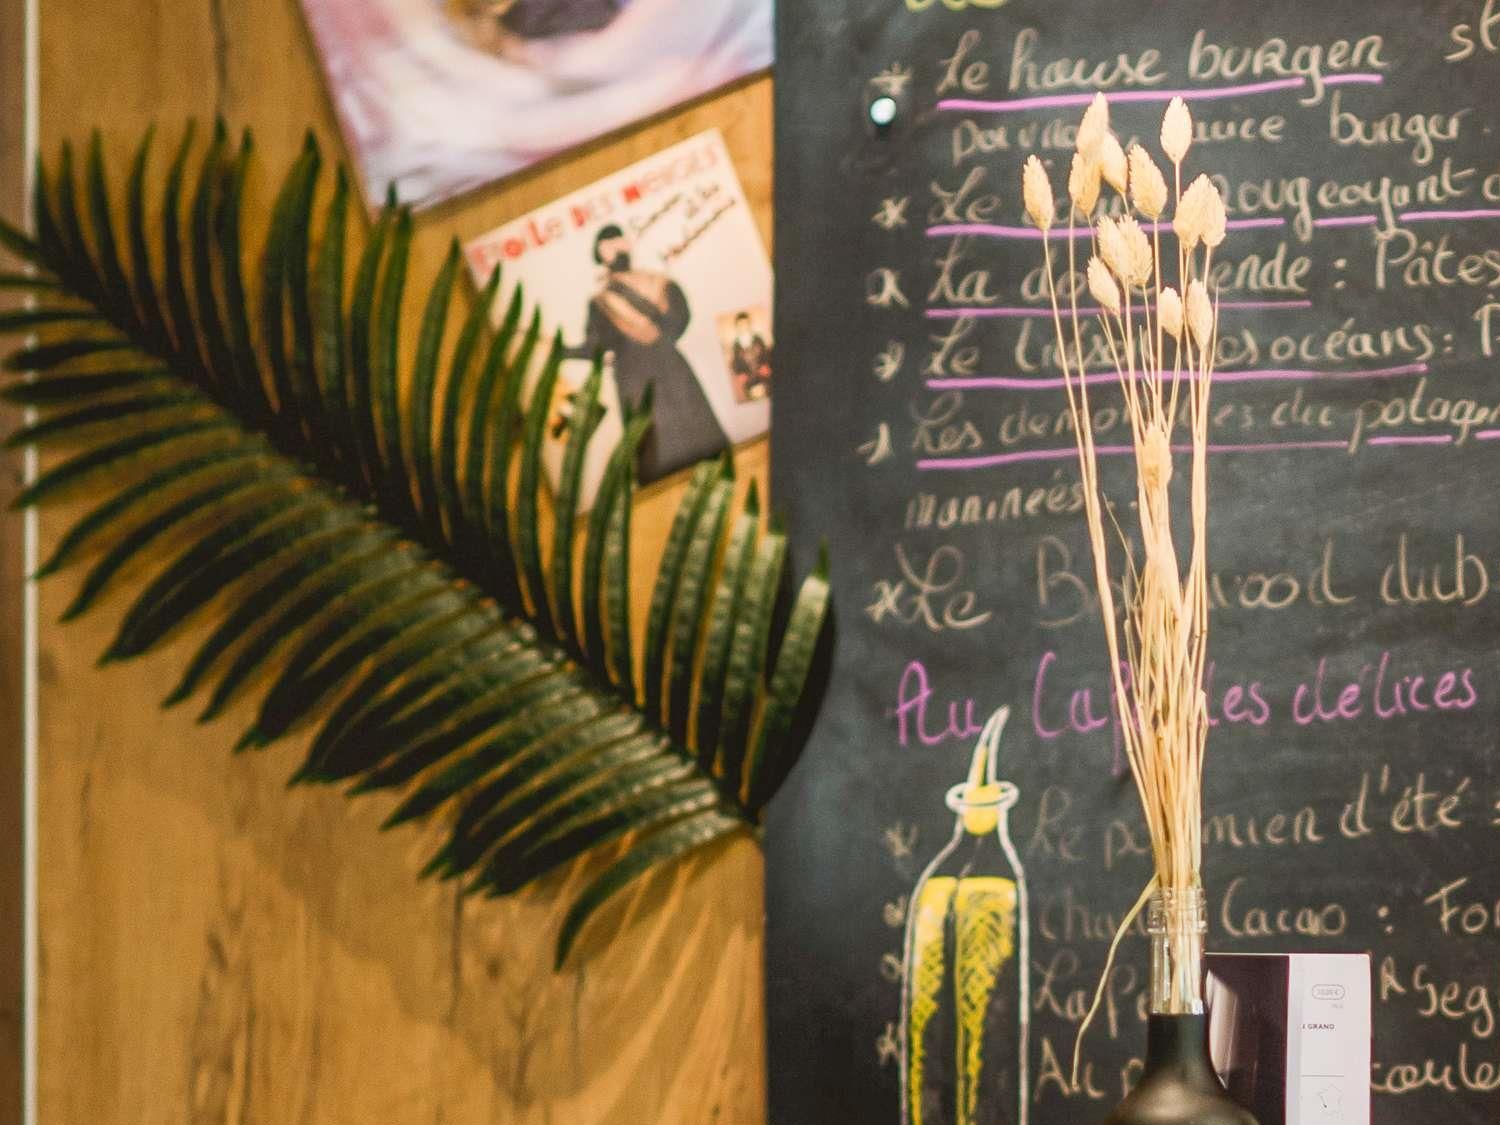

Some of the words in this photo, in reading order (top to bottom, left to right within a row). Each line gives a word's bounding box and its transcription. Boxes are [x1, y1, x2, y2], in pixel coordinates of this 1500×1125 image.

[1008, 28, 1168, 93] house
[1188, 29, 1388, 106] burger
[1293, 651, 1480, 726] délices
